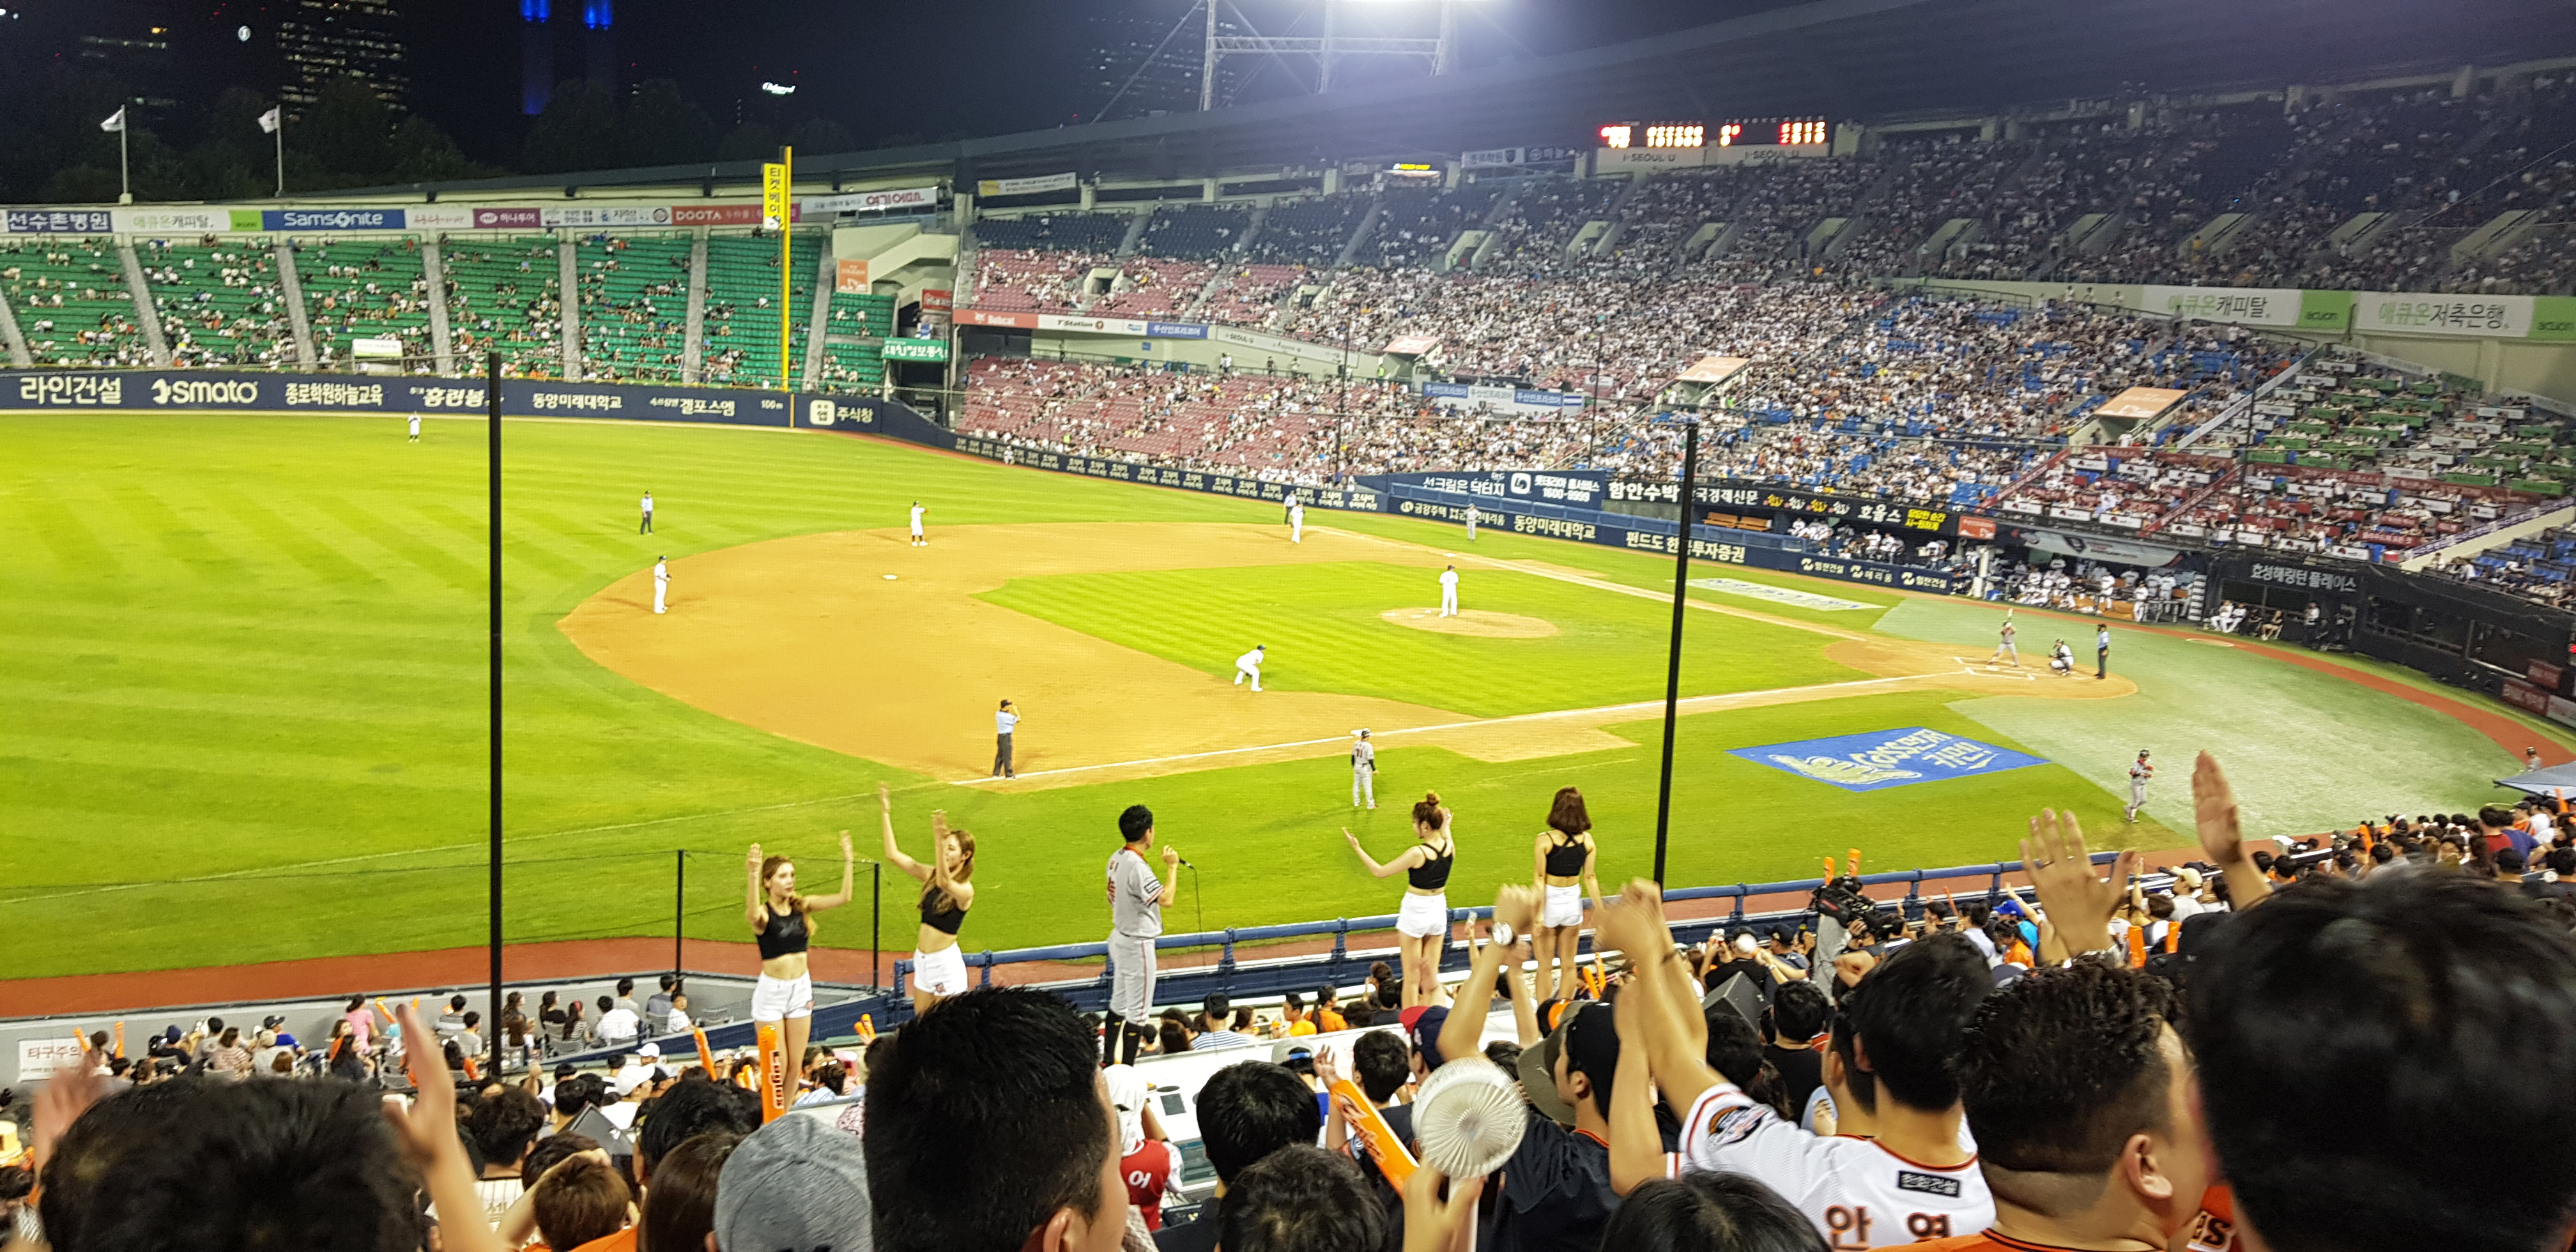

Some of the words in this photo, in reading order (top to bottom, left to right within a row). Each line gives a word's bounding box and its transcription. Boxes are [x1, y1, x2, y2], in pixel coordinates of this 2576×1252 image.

[9, 213, 109, 231] 선수촌병원
[283, 211, 383, 227] Samsonite
[676, 210, 723, 220] DOOTA
[20, 376, 122, 404] 라인건설
[171, 379, 257, 404] smato
[532, 393, 623, 410] 동양미래대학교
[837, 406, 874, 424] 주식창
[1423, 476, 1468, 494] 선크림은
[1470, 478, 1505, 496] 닥터지
[1543, 487, 1590, 502] 1600-9999
[1608, 481, 1680, 503] 함안수박
[1857, 503, 1902, 523] 호올스
[1514, 514, 1596, 540] 동양미래대학교
[1626, 531, 1664, 549] 펀드도
[2250, 562, 2308, 586] 효성해링턴
[2309, 572, 2358, 592] 플레이스
[27, 1046, 82, 1060] 타구주의
[1825, 1204, 1872, 1251] 안
